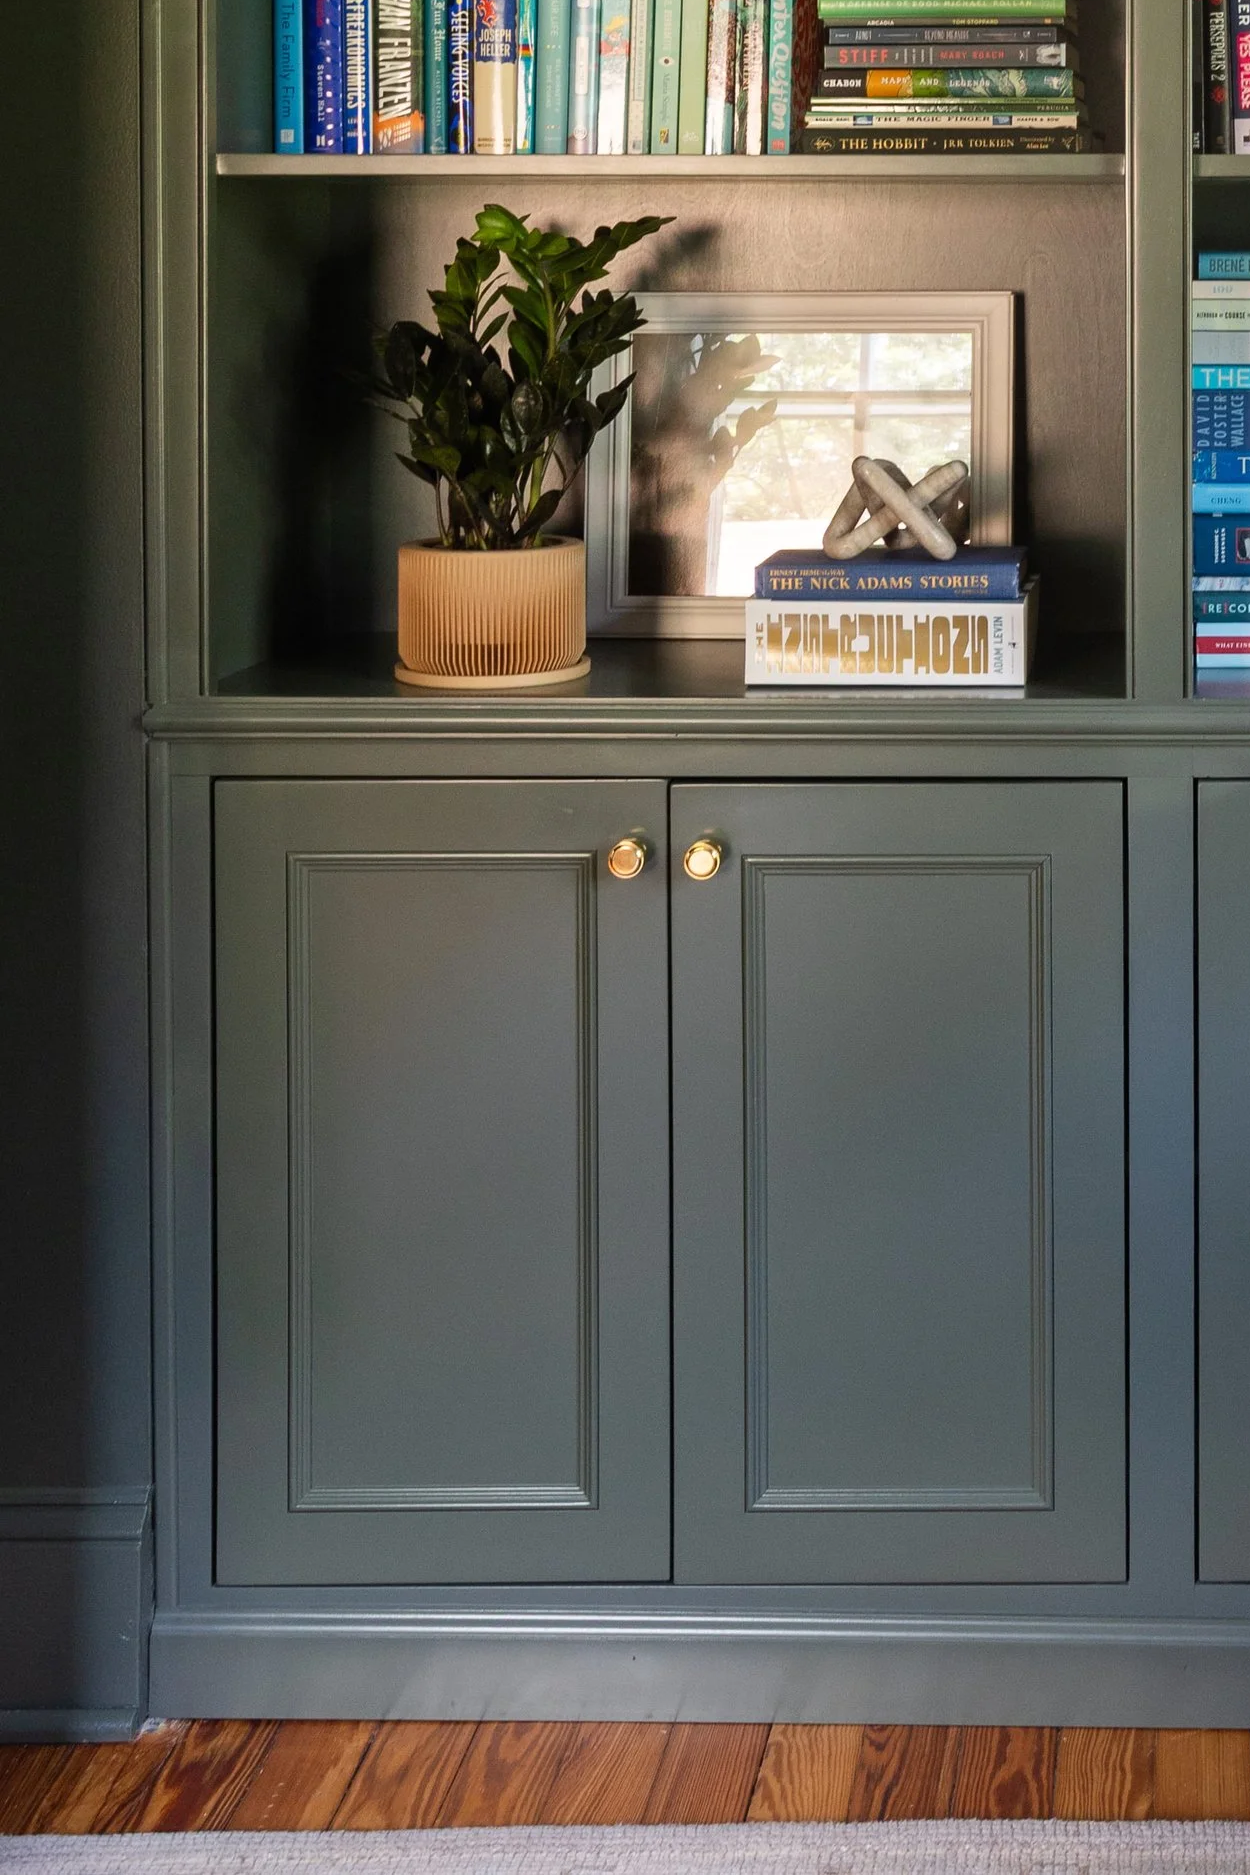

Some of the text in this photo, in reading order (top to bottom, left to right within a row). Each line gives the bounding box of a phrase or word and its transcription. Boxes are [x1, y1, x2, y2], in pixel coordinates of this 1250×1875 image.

[478, 28, 512, 43] JOSEPH
[1210, 11, 1225, 81] PERSEPOLIS 2
[279, 3, 296, 119] The Family Firm
[839, 48, 889, 64] STIFF
[378, 37, 412, 123] FRANZEN
[823, 76, 991, 88] CHABON MAPS AND LEGENDS
[839, 137, 928, 150] THE HOBBIT
[1209, 256, 1245, 273] BRENÉ
[1225, 310, 1246, 319] COURSE
[1201, 369, 1250, 387] THE
[1196, 394, 1210, 447] DAVID
[1213, 393, 1227, 447] FOSTER
[1231, 394, 1244, 447] WALLACE
[770, 575, 989, 591] THE NICK ADAMS STORIES
